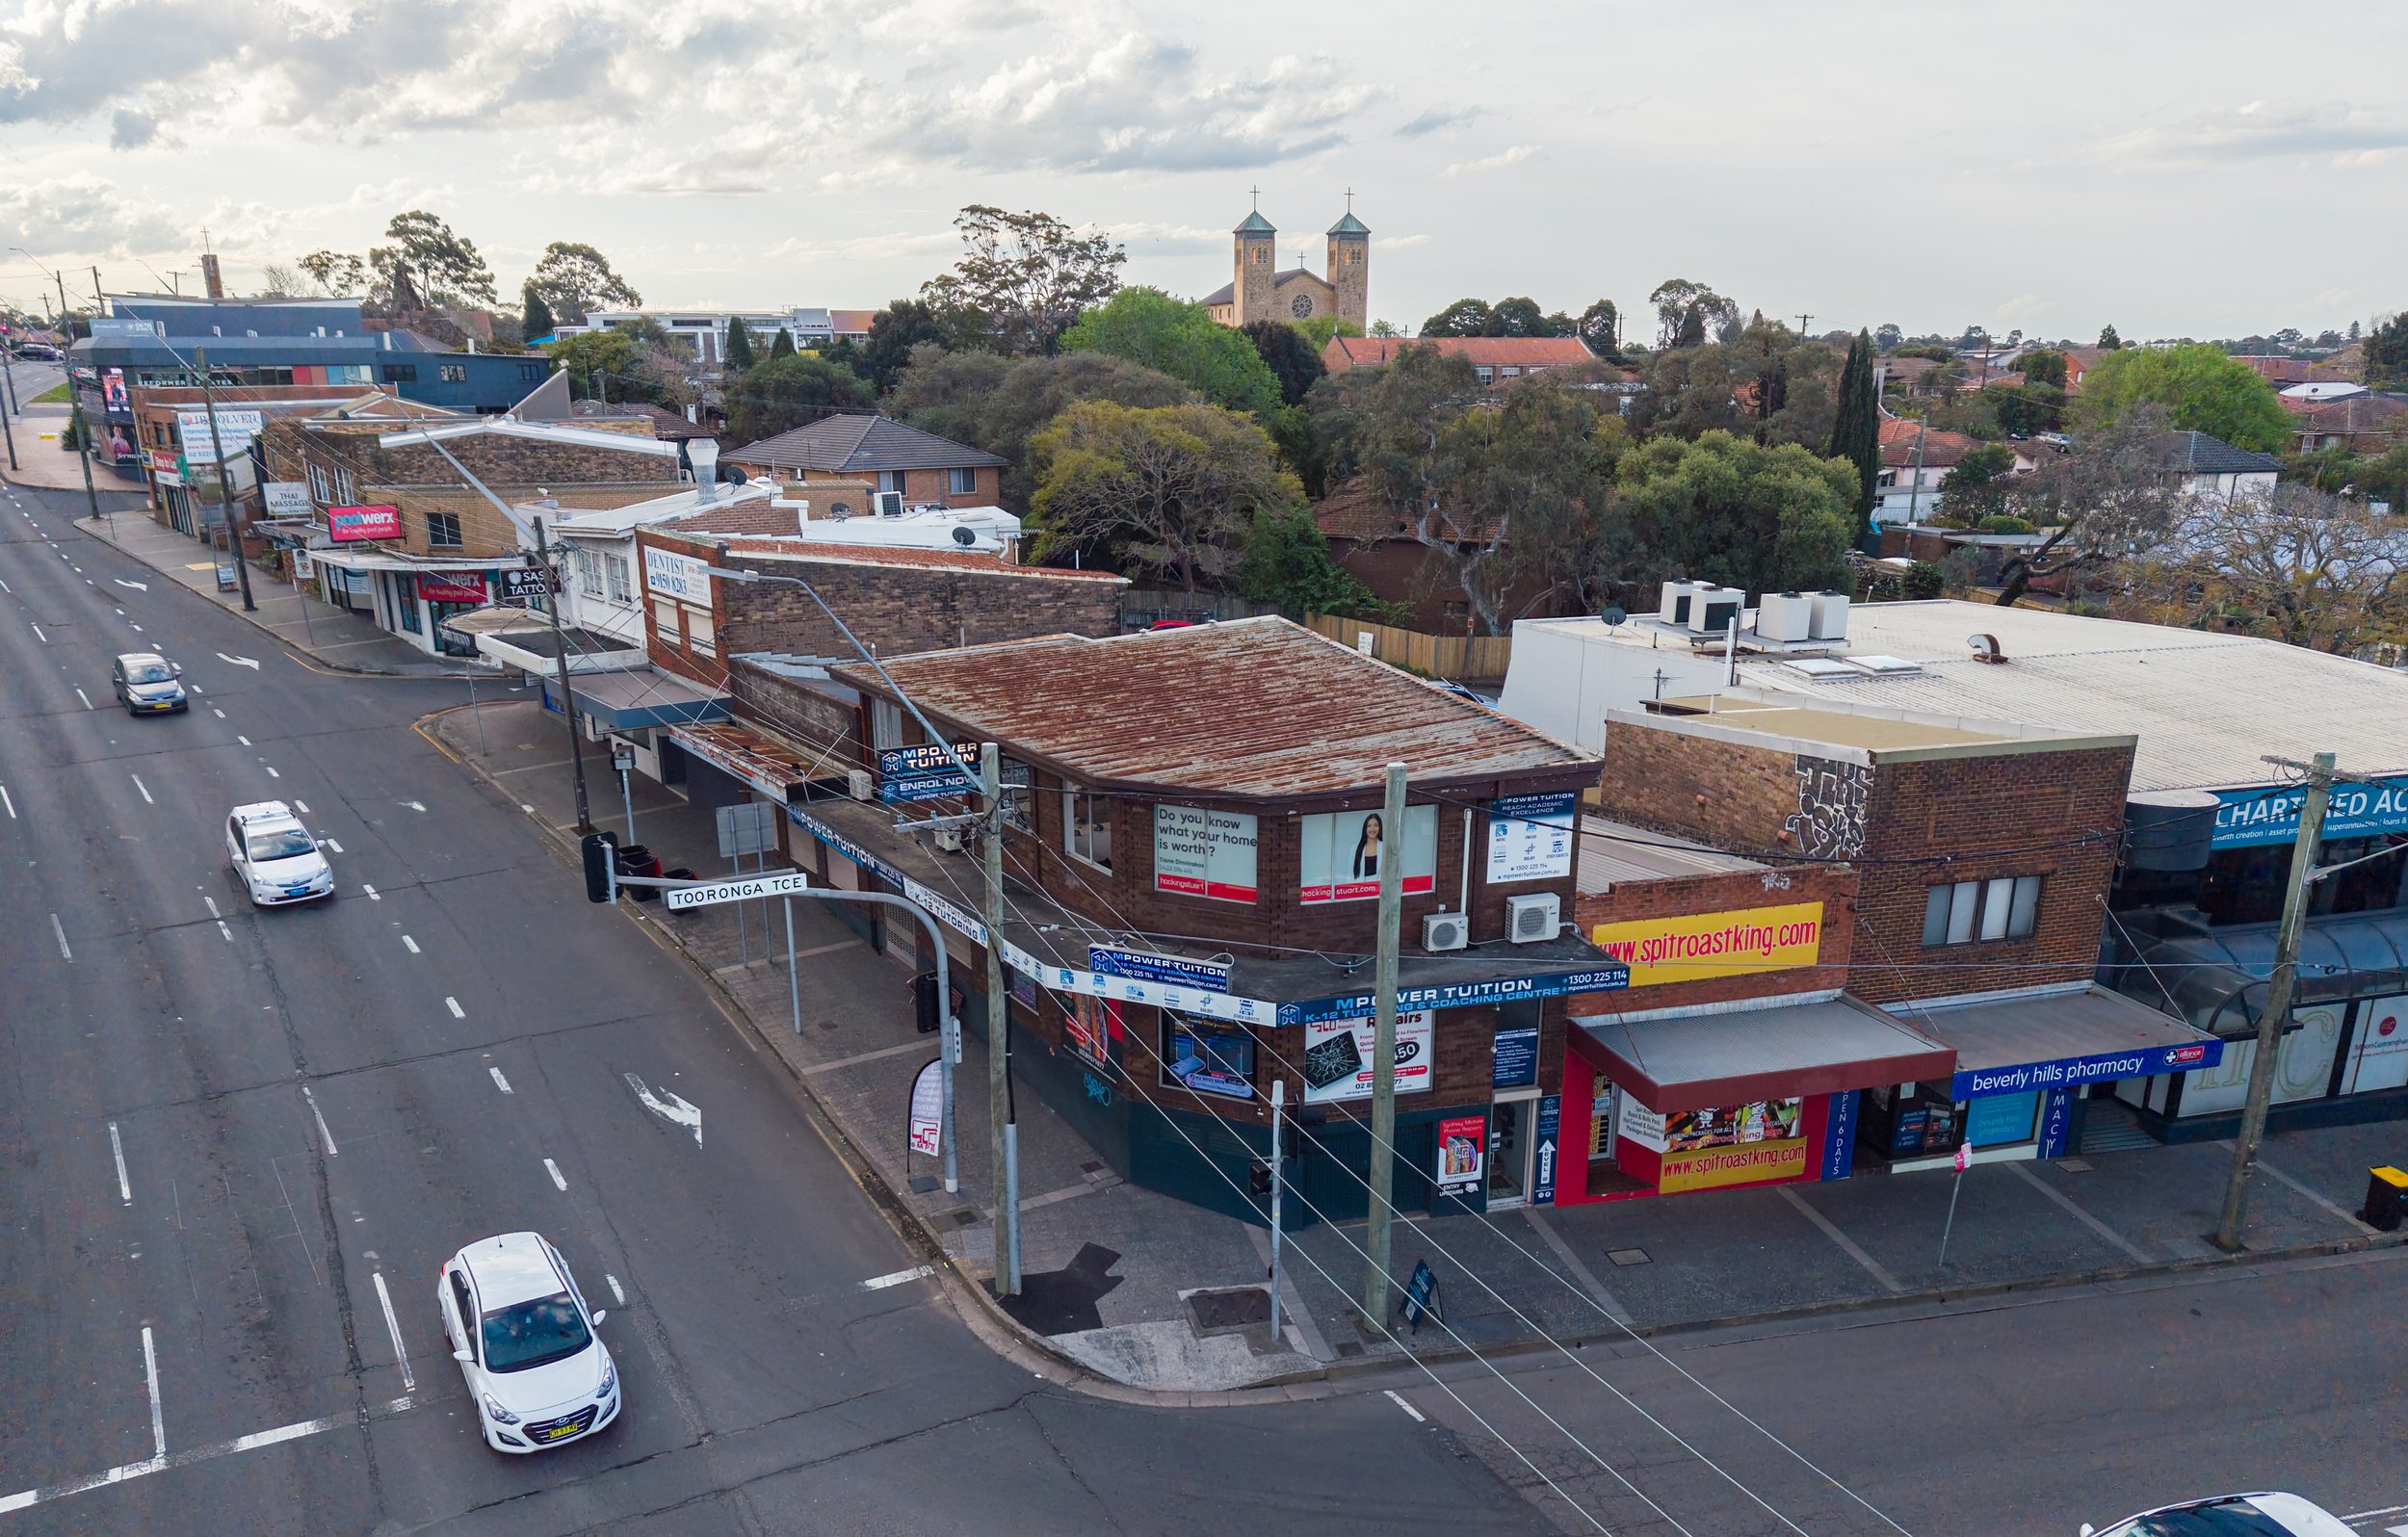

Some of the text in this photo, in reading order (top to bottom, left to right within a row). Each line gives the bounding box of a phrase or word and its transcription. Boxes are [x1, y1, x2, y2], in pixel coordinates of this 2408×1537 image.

[334, 511, 394, 532] poolwerx
[647, 551, 684, 576] DENTIST
[510, 585, 546, 595] TATTO
[900, 779, 944, 792] ENROL
[1500, 795, 1538, 804] MPOWER
[1159, 809, 1241, 829] Do you know
[1510, 807, 1555, 816] EXCELLENCE
[2214, 792, 2369, 828] CHARTED
[1159, 824, 1258, 847] what your home
[2212, 832, 2235, 841] ealth
[2236, 829, 2264, 840] creation
[2268, 827, 2287, 836] asset
[2326, 820, 2377, 831] superannuation
[835, 834, 876, 868] TUITION
[1159, 838, 1168, 849] is
[1171, 842, 1205, 854] worth
[674, 876, 801, 904] TOORONGA TCE
[1160, 877, 1204, 890] hockingstuart
[1301, 886, 1376, 898] hocking stuart.com
[914, 893, 979, 940] K-12 TUTORING
[947, 903, 973, 926] TUITION
[1113, 951, 1227, 977] MPOWER TUITION
[1119, 967, 1133, 977] 1300
[1164, 976, 1227, 991] mpowertuition.com.au
[1568, 970, 1628, 984] 1300 225 114
[1568, 981, 1627, 992] mpowertuition.com.au
[1336, 978, 1532, 1010] MPWER TUITION
[1305, 1011, 1338, 1023] K-12
[1342, 1003, 1414, 1019] TUTONG
[1430, 993, 1503, 1007] COACHING
[1505, 987, 1559, 1001] CENTRE
[1367, 1012, 1423, 1028] Rairs
[1972, 1055, 2144, 1091] beverly hills pharmacy
[1838, 1126, 1845, 1134] 6
[1833, 1138, 1844, 1175] DAYS
